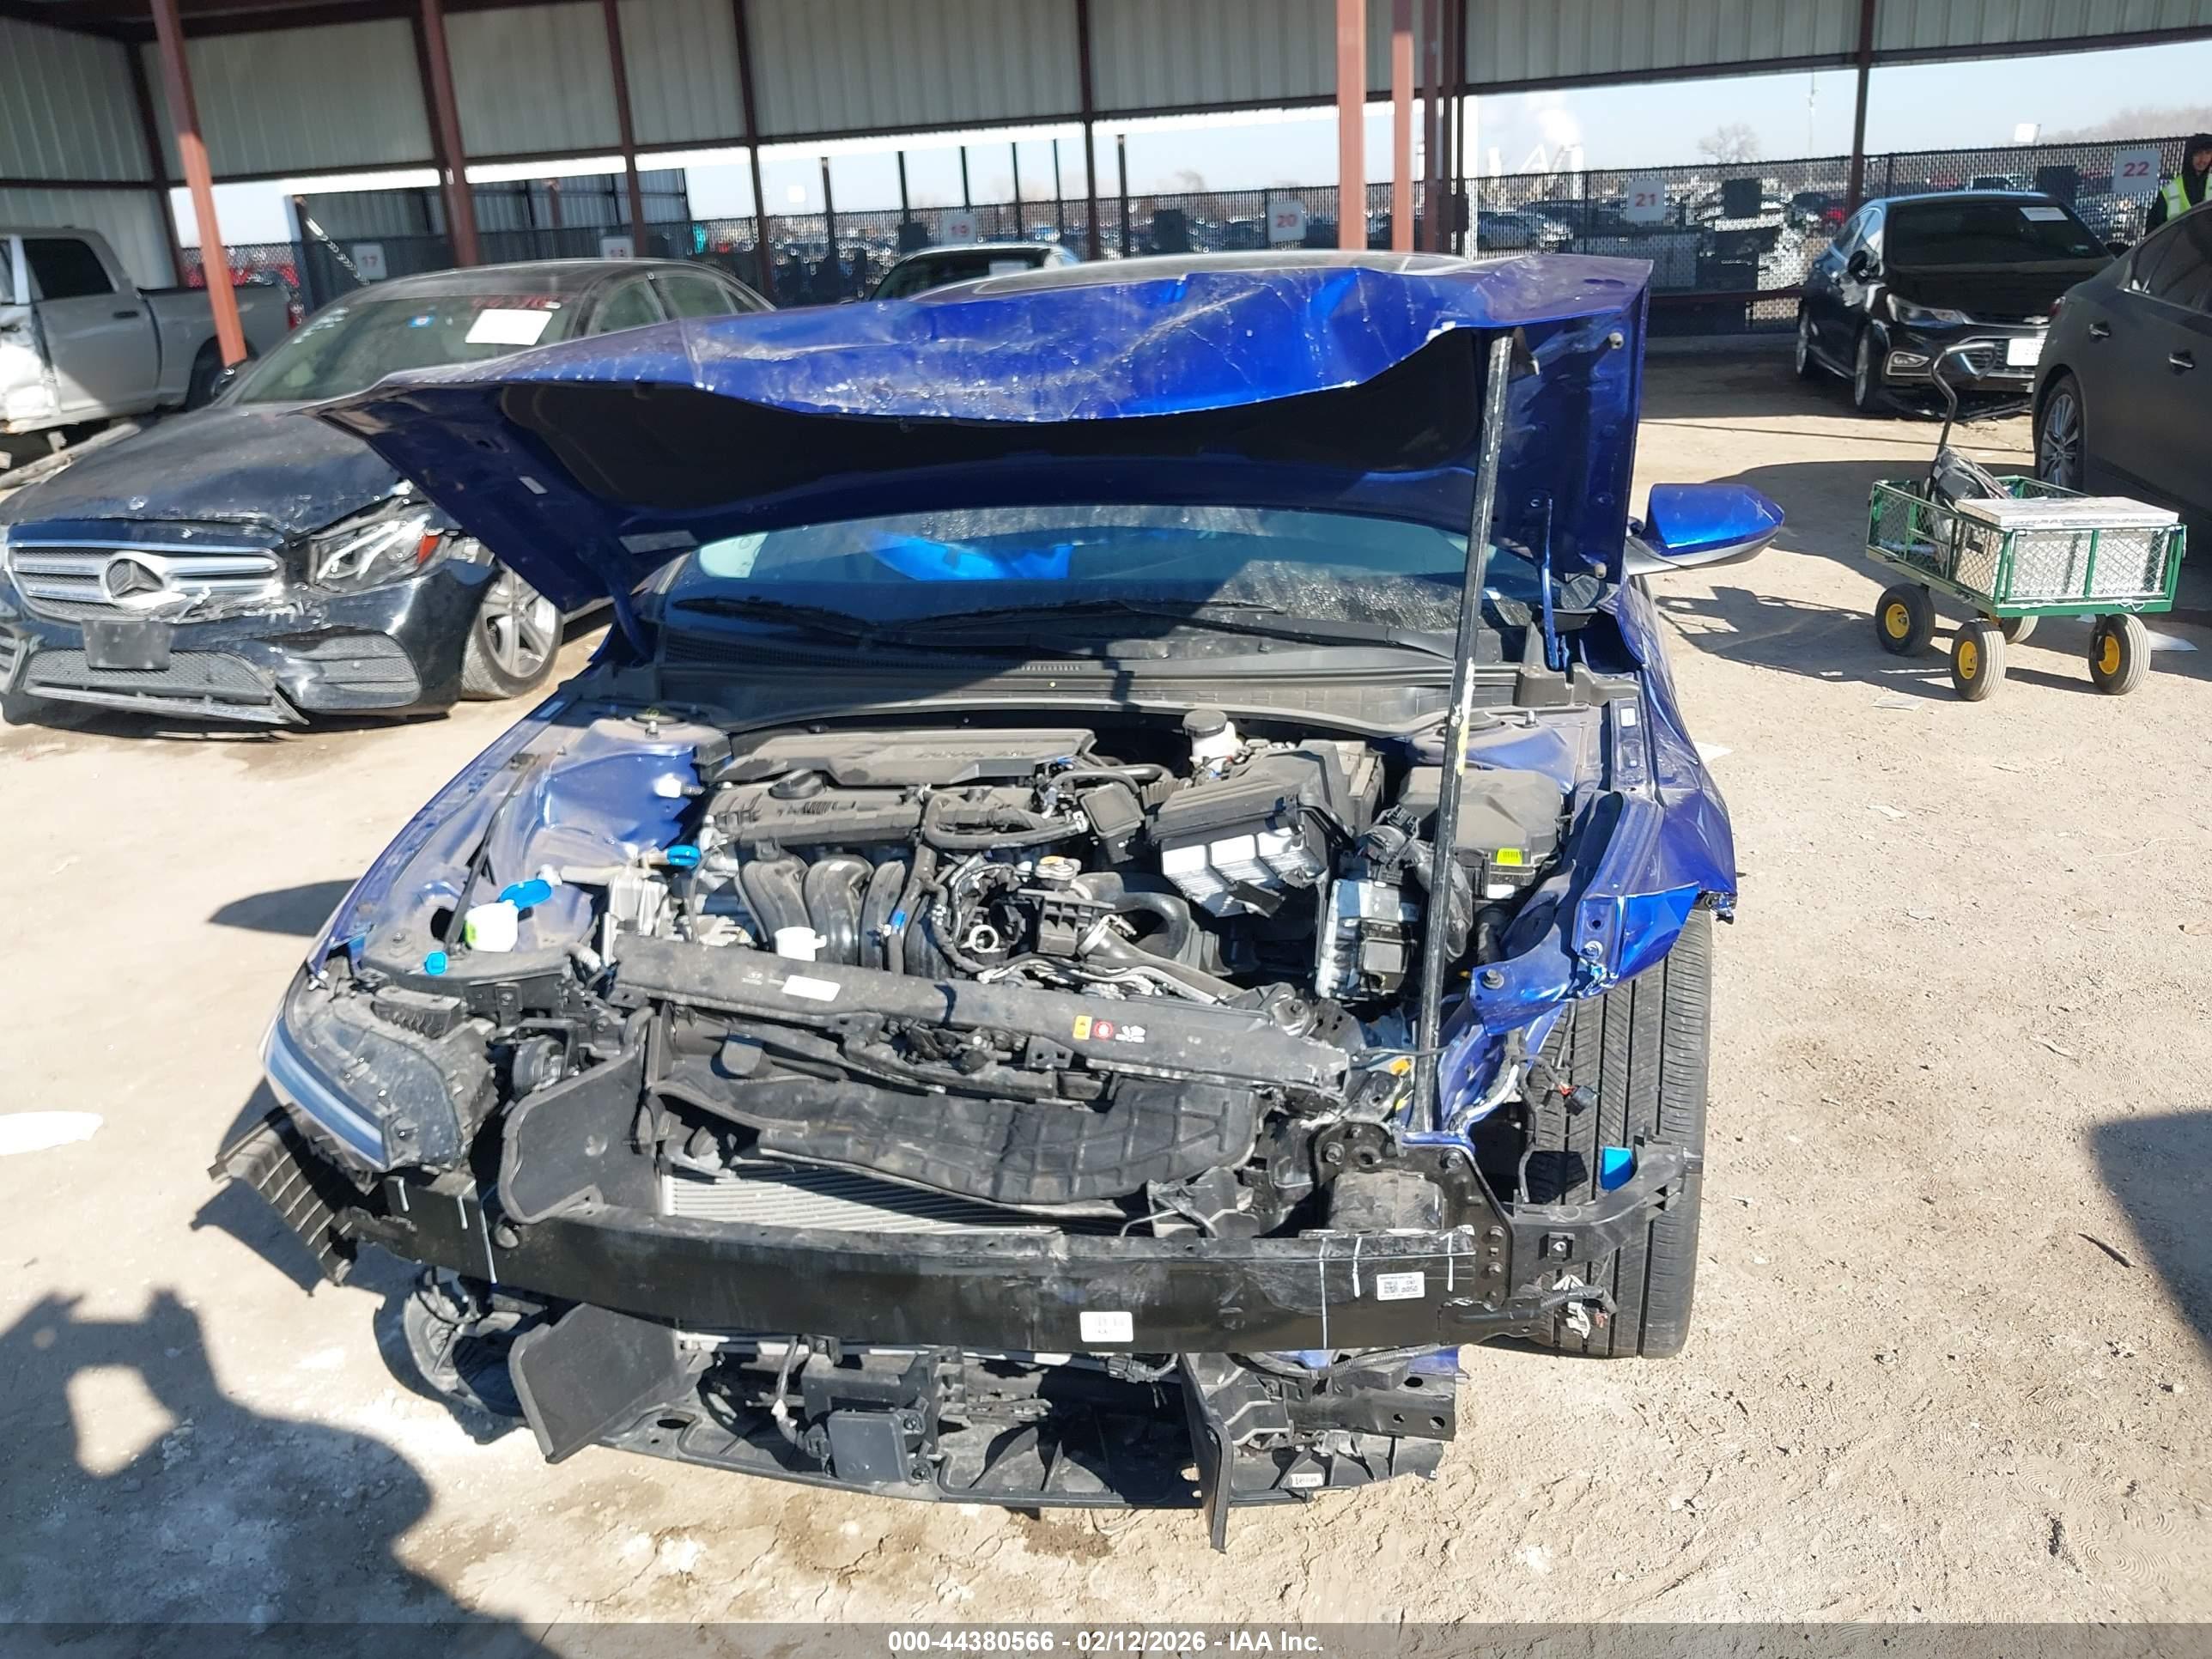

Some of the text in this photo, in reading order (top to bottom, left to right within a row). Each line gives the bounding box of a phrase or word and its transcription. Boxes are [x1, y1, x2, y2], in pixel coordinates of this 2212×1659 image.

[2122, 161, 2150, 177] 22
[1635, 192, 1656, 207] 21
[1276, 213, 1297, 228] 20
